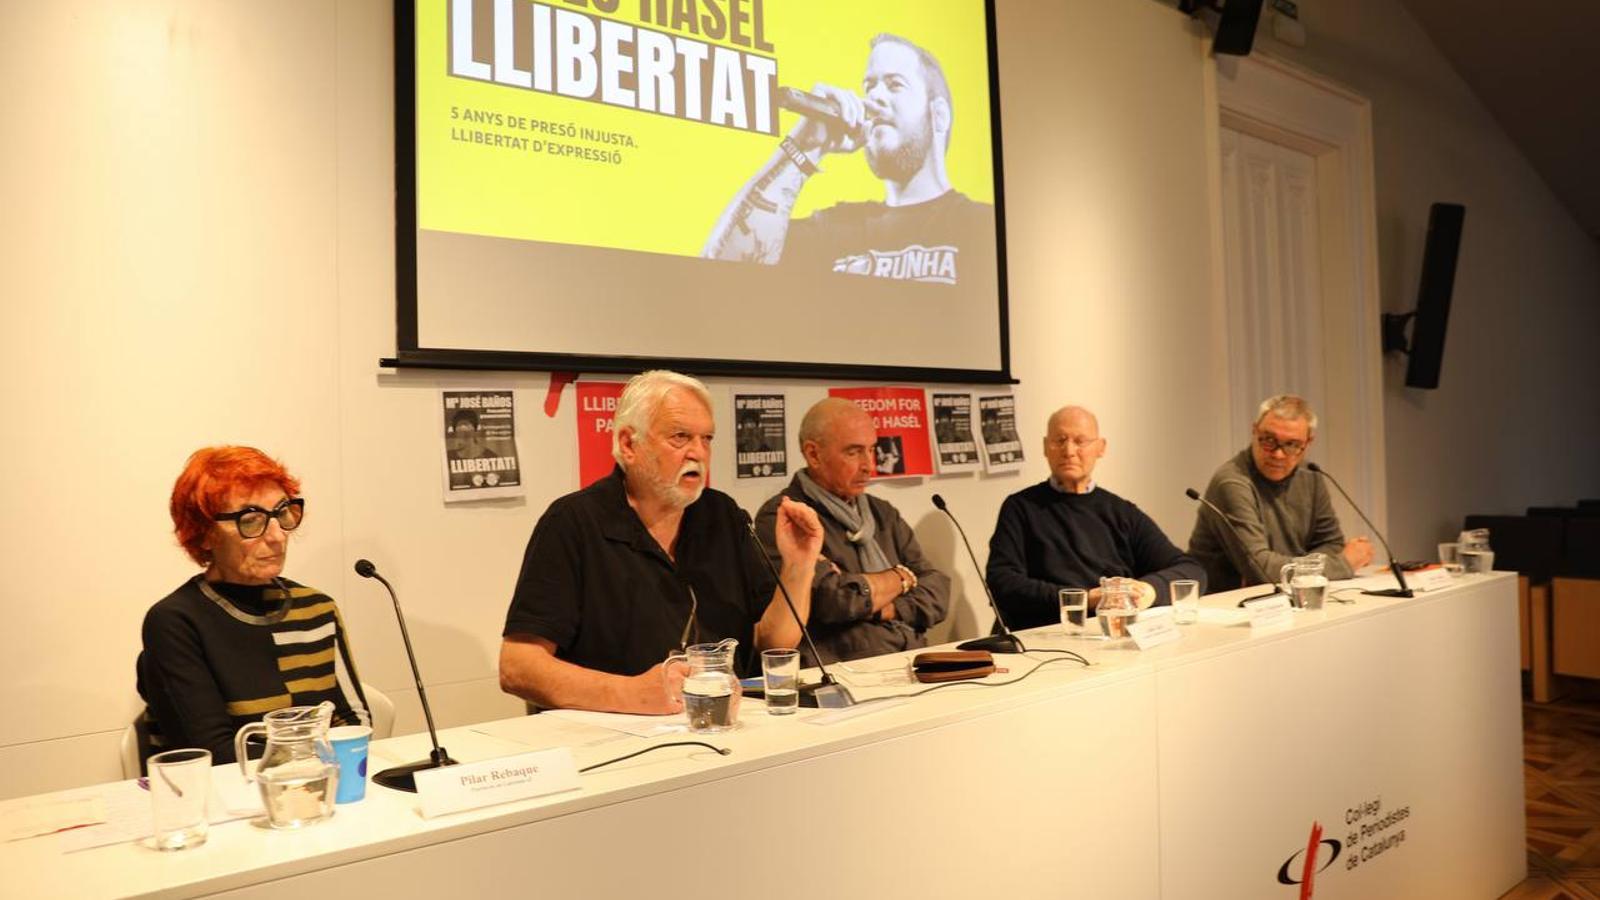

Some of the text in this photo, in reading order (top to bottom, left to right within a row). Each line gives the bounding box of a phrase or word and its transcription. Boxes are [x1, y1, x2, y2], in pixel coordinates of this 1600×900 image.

[452, 0, 776, 134] LLIBERTAT
[451, 107, 639, 148] 5 ANYS DE PRESÓ INJUSTA.
[451, 128, 622, 165] LLIBERTAT D'EXPRESSIÓ
[883, 411, 921, 429] HASÉL
[899, 398, 921, 412] FOR
[450, 456, 517, 473] LLIBERTAT!
[460, 774, 489, 787] Pilar
[491, 765, 540, 781] Rebaque
[1345, 806, 1410, 848] de Periodistes
[1345, 829, 1406, 871] de Catalunya
